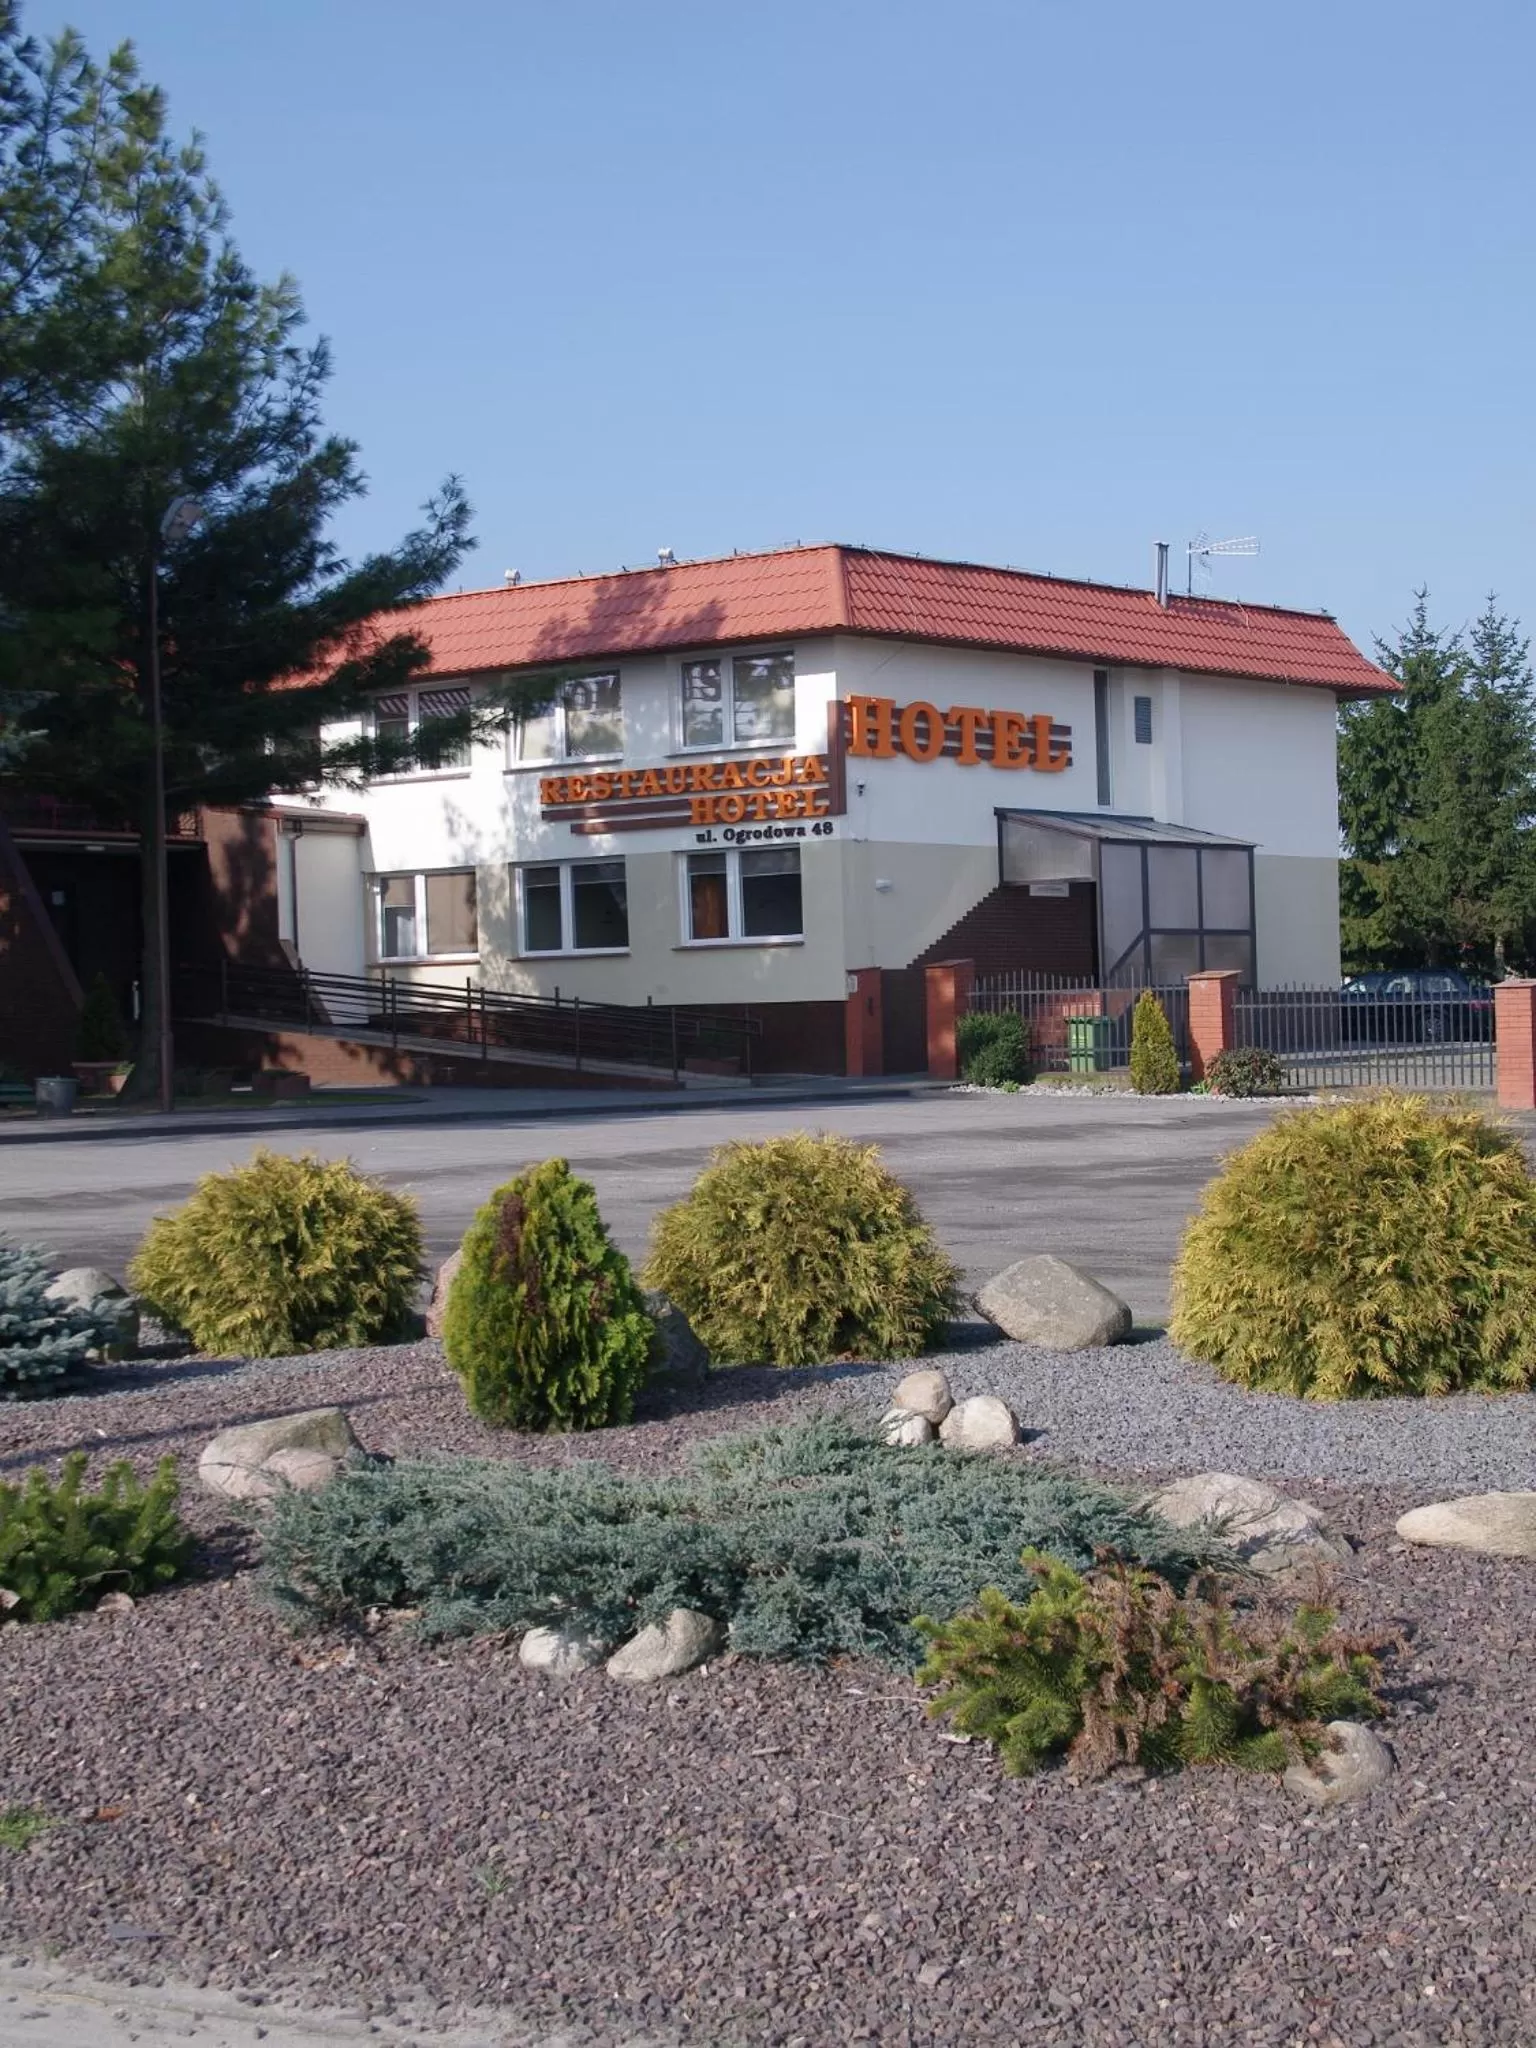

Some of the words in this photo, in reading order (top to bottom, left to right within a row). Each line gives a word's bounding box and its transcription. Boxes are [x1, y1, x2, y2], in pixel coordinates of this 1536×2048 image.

[847, 695, 1068, 773] HOTEL
[540, 754, 827, 805] RESTAURACJA
[688, 788, 829, 825] HOTEL
[695, 829, 717, 843] ul.
[723, 825, 806, 844] Ogrodowa
[811, 821, 834, 836] 48
